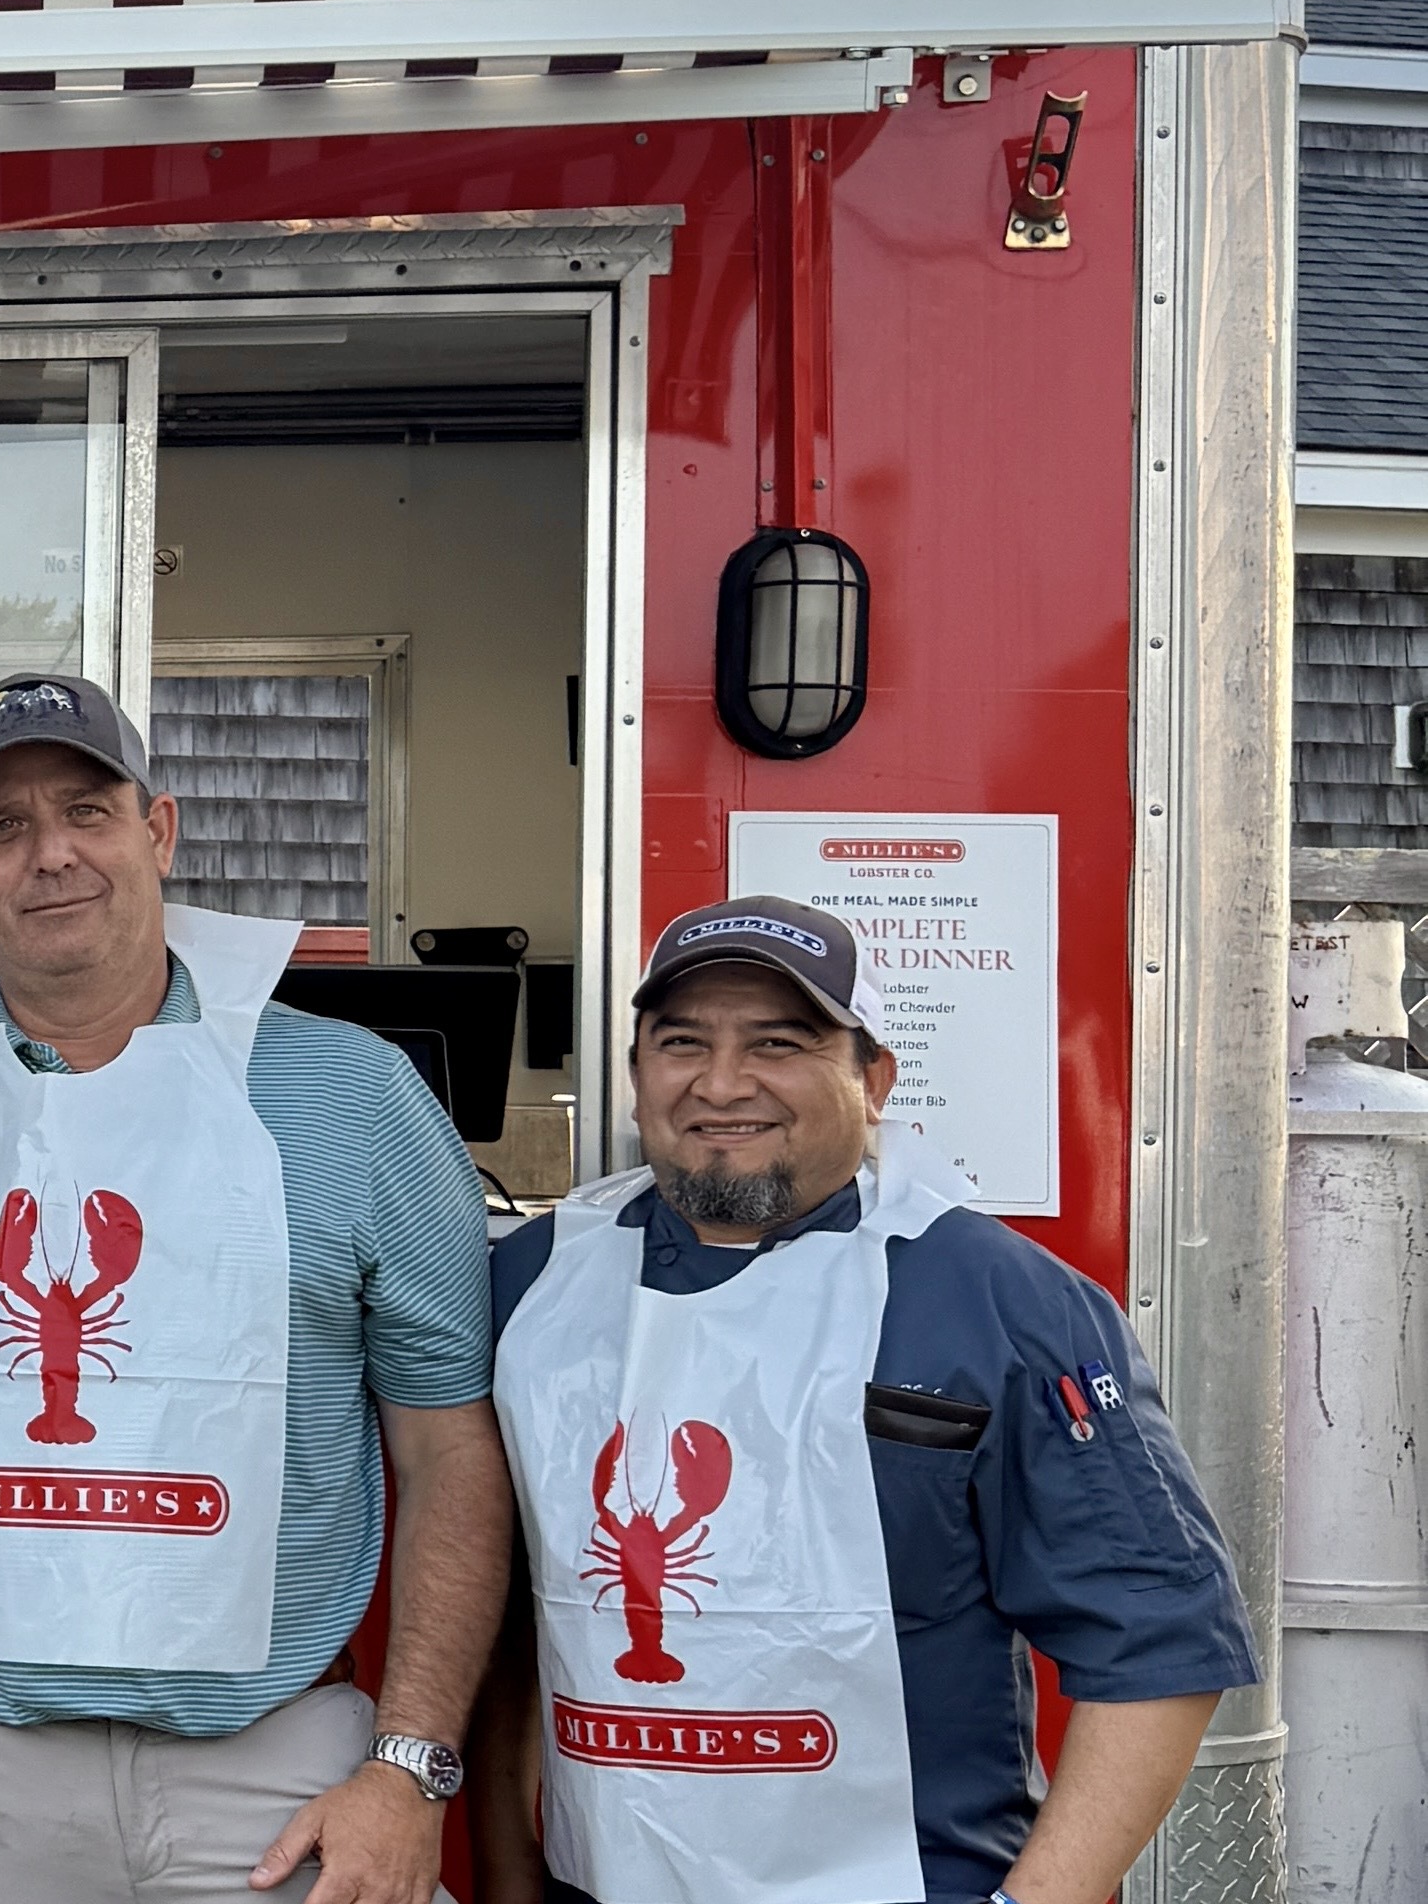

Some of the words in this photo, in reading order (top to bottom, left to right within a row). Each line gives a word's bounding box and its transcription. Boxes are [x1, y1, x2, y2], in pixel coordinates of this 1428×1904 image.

[842, 844, 945, 857] MILLIE'S
[850, 867, 910, 878] LOBSTER
[914, 868, 935, 879] CO.
[811, 895, 839, 906] ONE
[888, 896, 926, 907] MADE
[930, 896, 978, 907] SIMPLE
[842, 917, 966, 940] MPLETE
[901, 949, 1015, 971] DINNER
[884, 983, 930, 994] Lobster
[899, 1001, 956, 1013] Chowder
[883, 1040, 929, 1050] otatoes
[896, 1078, 930, 1088] utter
[926, 1095, 947, 1107] Bib
[565, 1715, 782, 1756] MILLIE'S
